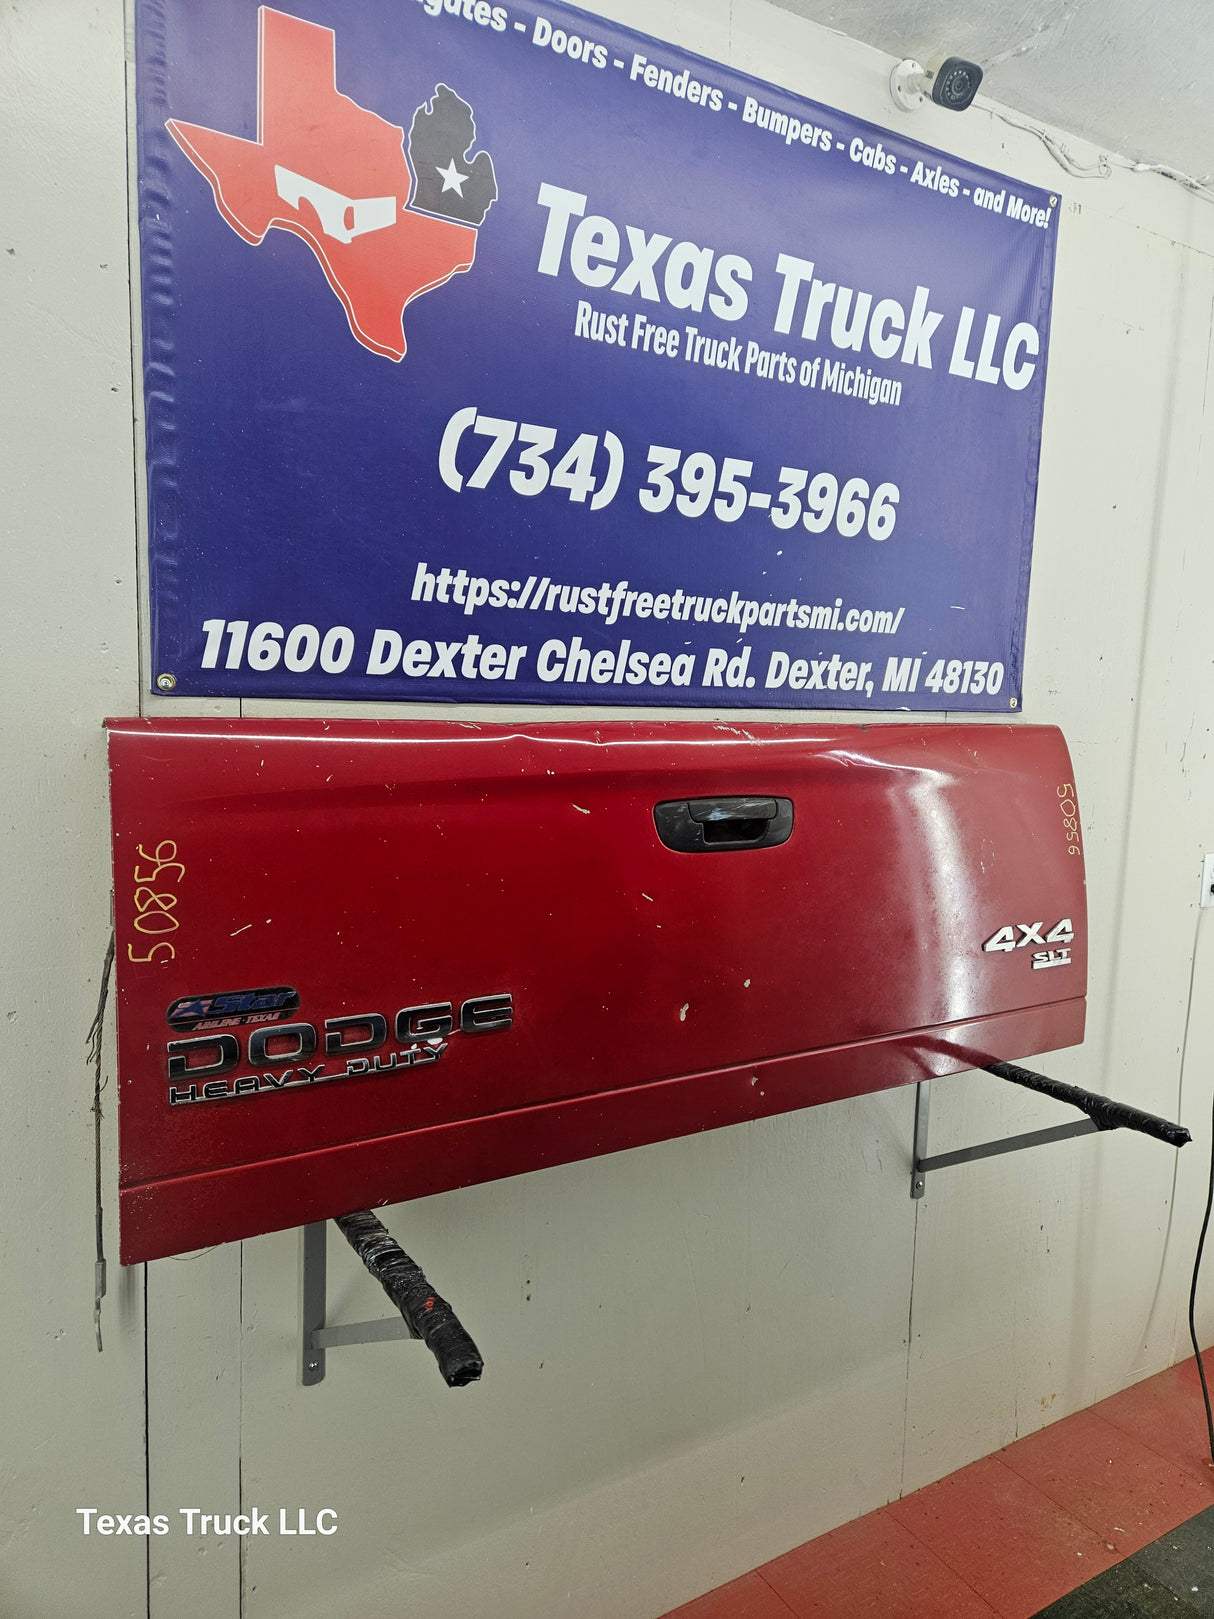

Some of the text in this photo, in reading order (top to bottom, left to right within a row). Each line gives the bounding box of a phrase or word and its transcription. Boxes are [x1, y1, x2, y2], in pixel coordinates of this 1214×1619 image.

[416, 0, 508, 32] gates
[532, 16, 608, 69] Doors
[629, 53, 724, 112] Fenders
[742, 95, 833, 152] Bumpers
[849, 137, 897, 175] Cabs
[909, 160, 960, 198] Axles
[973, 187, 1007, 214] and
[1006, 194, 1052, 229] More!
[536, 181, 1040, 391] Texas Truck LLC
[574, 299, 902, 406] Rust Free Truck Parts of Michigan
[438, 406, 901, 542] (734) 395-3966
[410, 562, 906, 634] https://rustfreetruckpartsmi.com/
[201, 619, 1005, 698] 11600 Dexter Chelsea Rd. Dexter, MI 48130
[1056, 783, 1081, 856] 50856
[127, 839, 185, 963] 50856
[1032, 947, 1072, 966] SLT
[166, 993, 513, 1081] DODGE
[191, 1012, 281, 1031] ABILENE TEXAS
[169, 1042, 449, 1106] HEAVY DUTY
